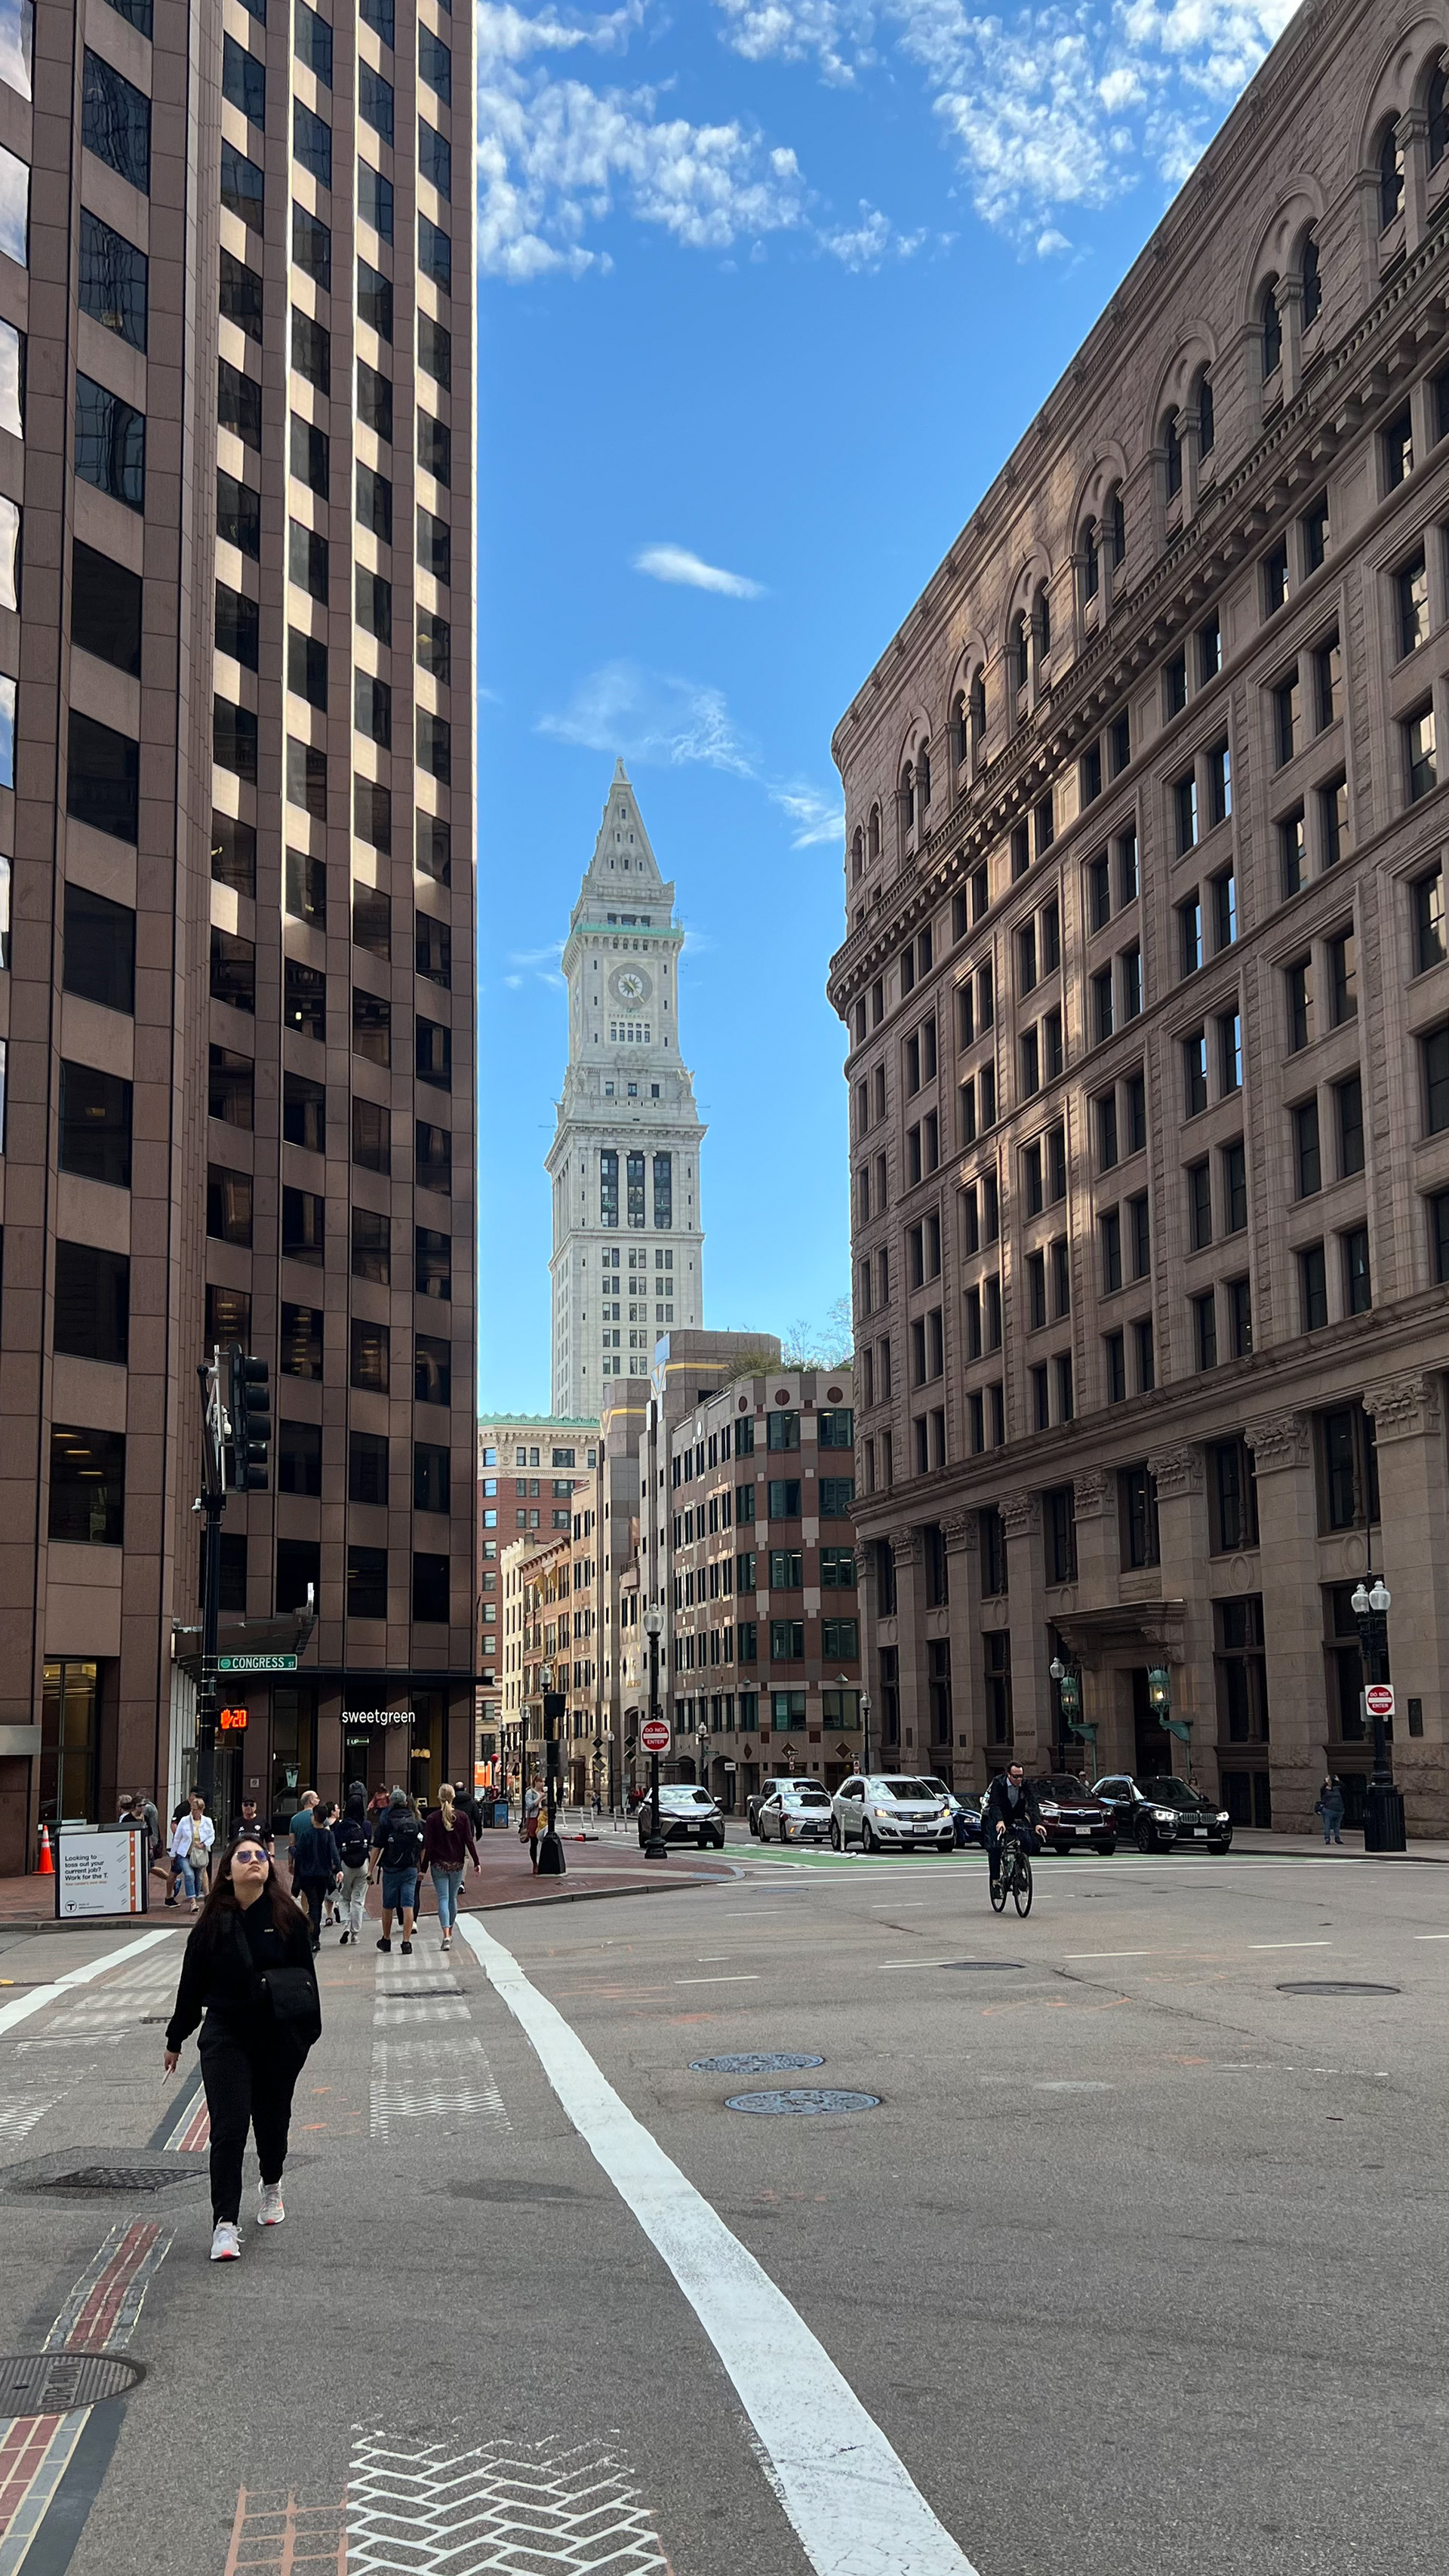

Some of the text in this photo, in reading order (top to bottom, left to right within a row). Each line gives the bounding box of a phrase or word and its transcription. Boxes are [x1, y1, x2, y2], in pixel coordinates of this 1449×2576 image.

[232, 1657, 285, 1669] CONGRESS
[232, 1710, 247, 1728] 20
[342, 1709, 415, 1725] sweetgreen
[42, 2363, 80, 2405] DRAIN
